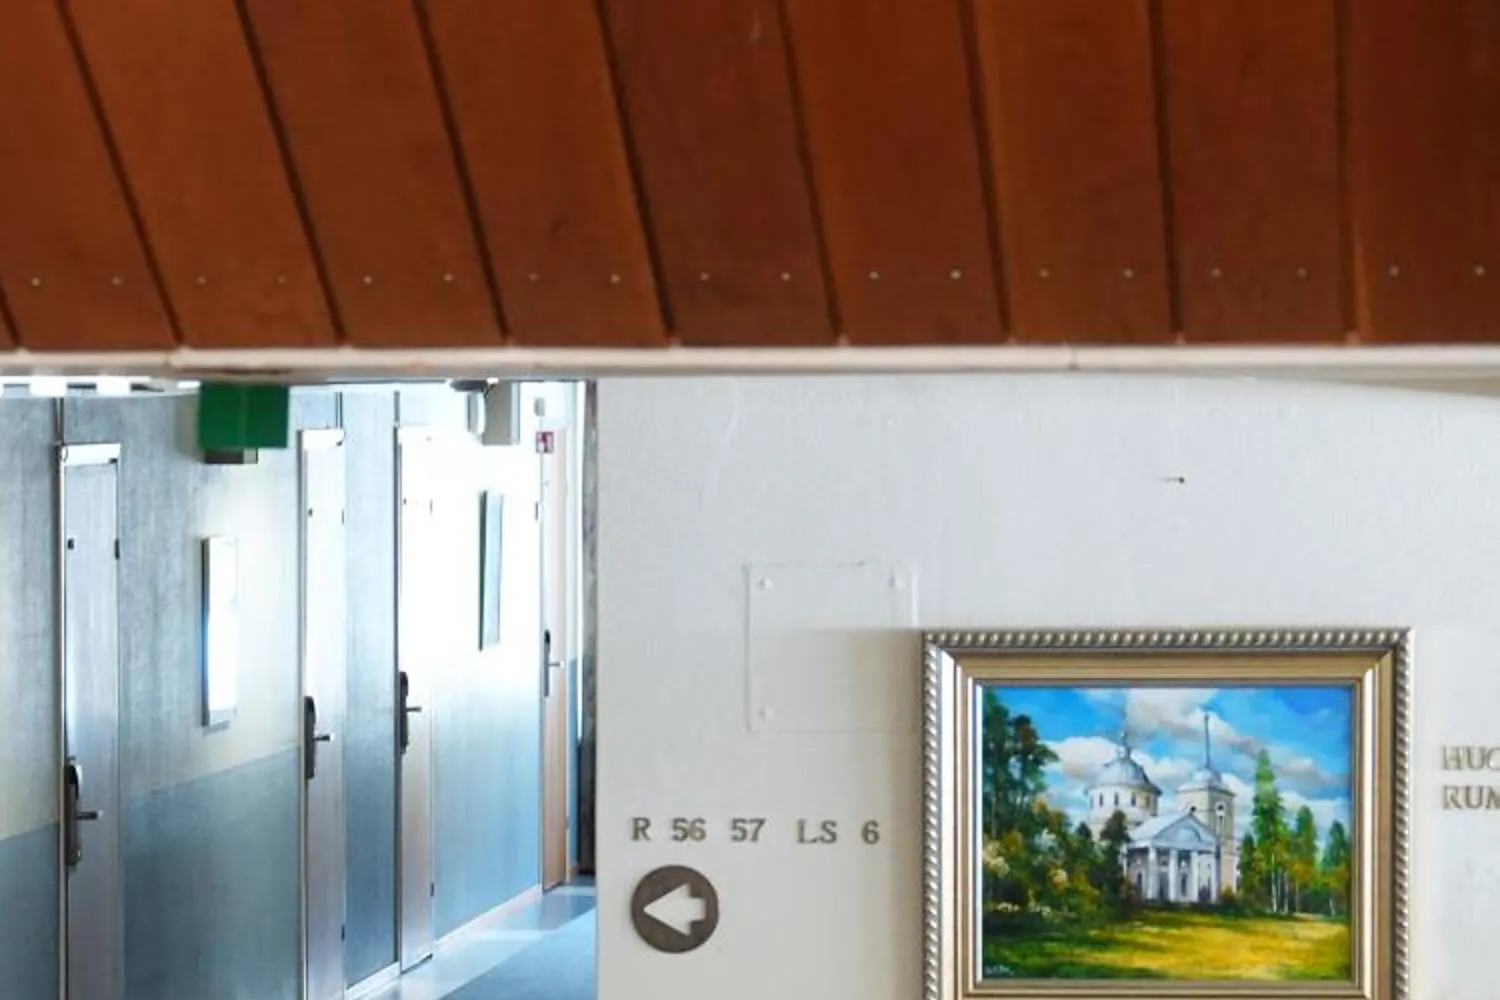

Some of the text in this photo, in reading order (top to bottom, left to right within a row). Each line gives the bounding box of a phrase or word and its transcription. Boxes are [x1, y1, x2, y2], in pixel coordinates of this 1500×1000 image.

[630, 816, 652, 842] R
[671, 817, 706, 842] 56
[730, 818, 765, 843] 57
[861, 819, 880, 845] 6
